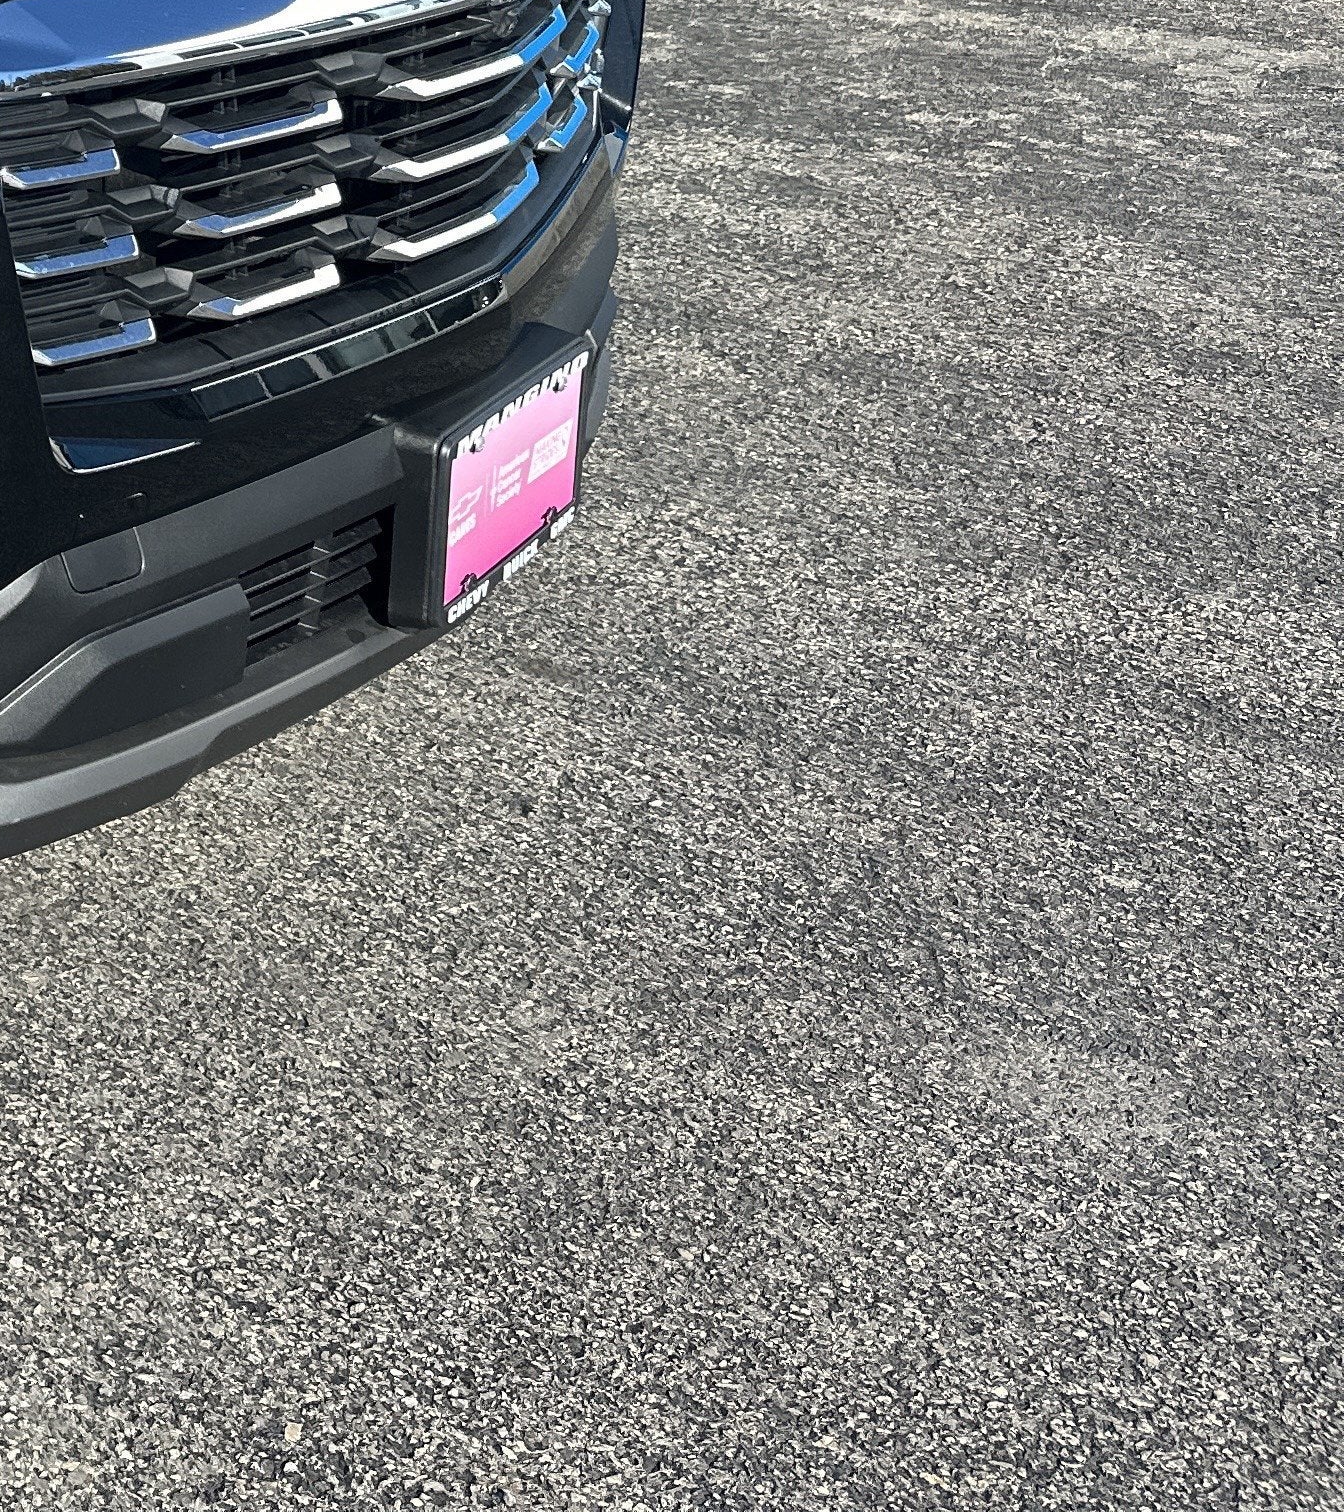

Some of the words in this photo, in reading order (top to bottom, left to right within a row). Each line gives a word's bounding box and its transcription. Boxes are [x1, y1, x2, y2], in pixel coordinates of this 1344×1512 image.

[455, 351, 590, 460] MANGINO
[447, 579, 490, 624] CHEVY
[503, 538, 539, 582] BUICK
[550, 506, 576, 539] GMC
